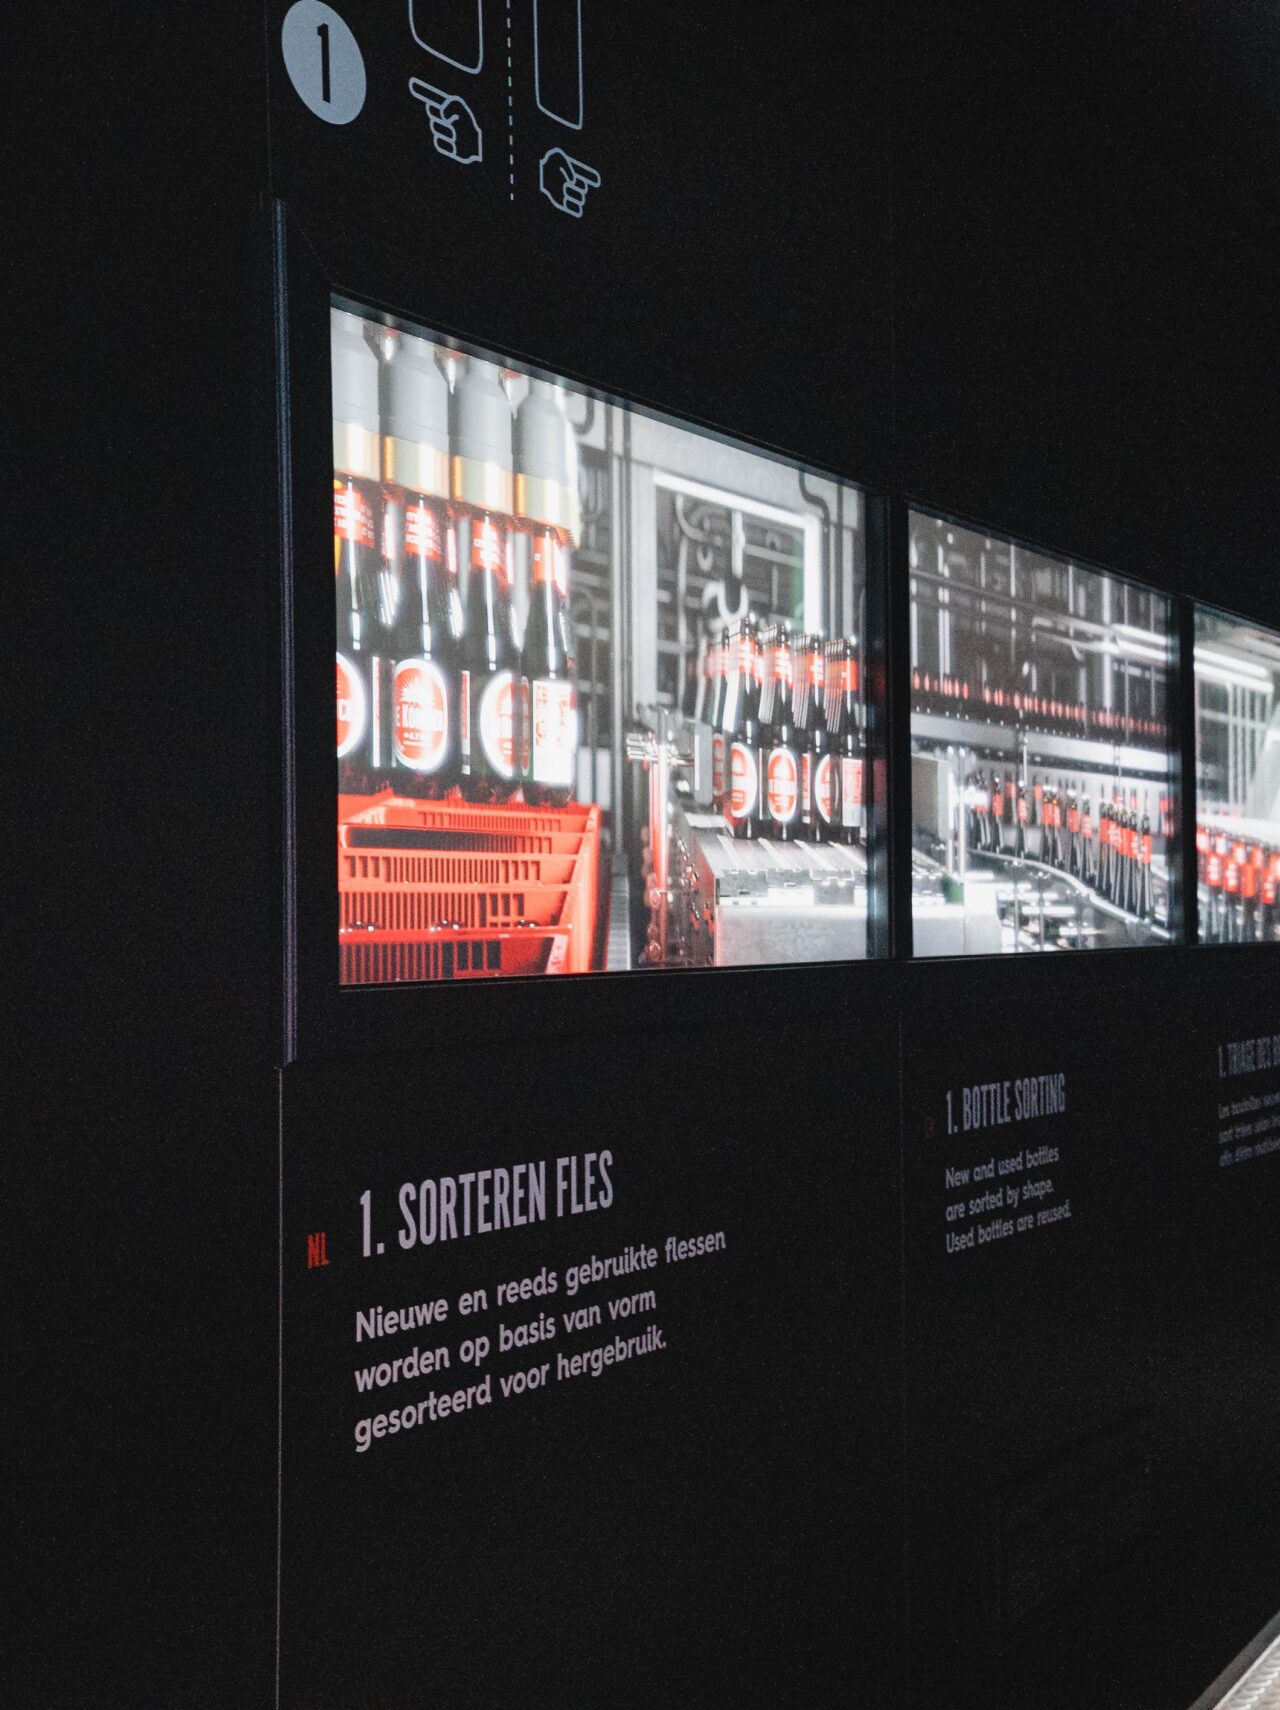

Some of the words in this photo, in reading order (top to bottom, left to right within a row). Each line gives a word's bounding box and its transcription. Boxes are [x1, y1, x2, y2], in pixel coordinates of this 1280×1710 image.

[316, 23, 331, 104] 1
[946, 1090, 959, 1135] 1.
[963, 1081, 1012, 1131] BOTTLE
[1014, 1073, 1066, 1120] SORTING
[945, 1167, 970, 1189] New
[973, 1158, 996, 1182] and
[999, 1152, 1024, 1175] used
[1026, 1146, 1060, 1169] bottles
[946, 1203, 966, 1222] are
[969, 1187, 1004, 1215] sorted
[1006, 1184, 1020, 1208] by
[360, 1189, 385, 1257] 1.
[398, 1160, 546, 1249] SORTEREN
[556, 1150, 613, 1217] FLES
[945, 1227, 975, 1254] Used
[977, 1218, 1014, 1245] bottles
[1017, 1214, 1034, 1230] are
[308, 1232, 329, 1269] NL
[355, 1298, 448, 1342] Nieuwe
[458, 1289, 488, 1315] en
[497, 1267, 558, 1306] reeds
[566, 1246, 658, 1296] gebruikte
[666, 1229, 726, 1264] flessen
[354, 1346, 450, 1393] worden
[459, 1334, 490, 1367] op
[499, 1312, 556, 1352] basis
[563, 1305, 602, 1333] van
[608, 1289, 656, 1320] vorm
[354, 1374, 492, 1453] gesorteerd
[499, 1363, 550, 1398] voor
[556, 1324, 667, 1381] hergebruik.
